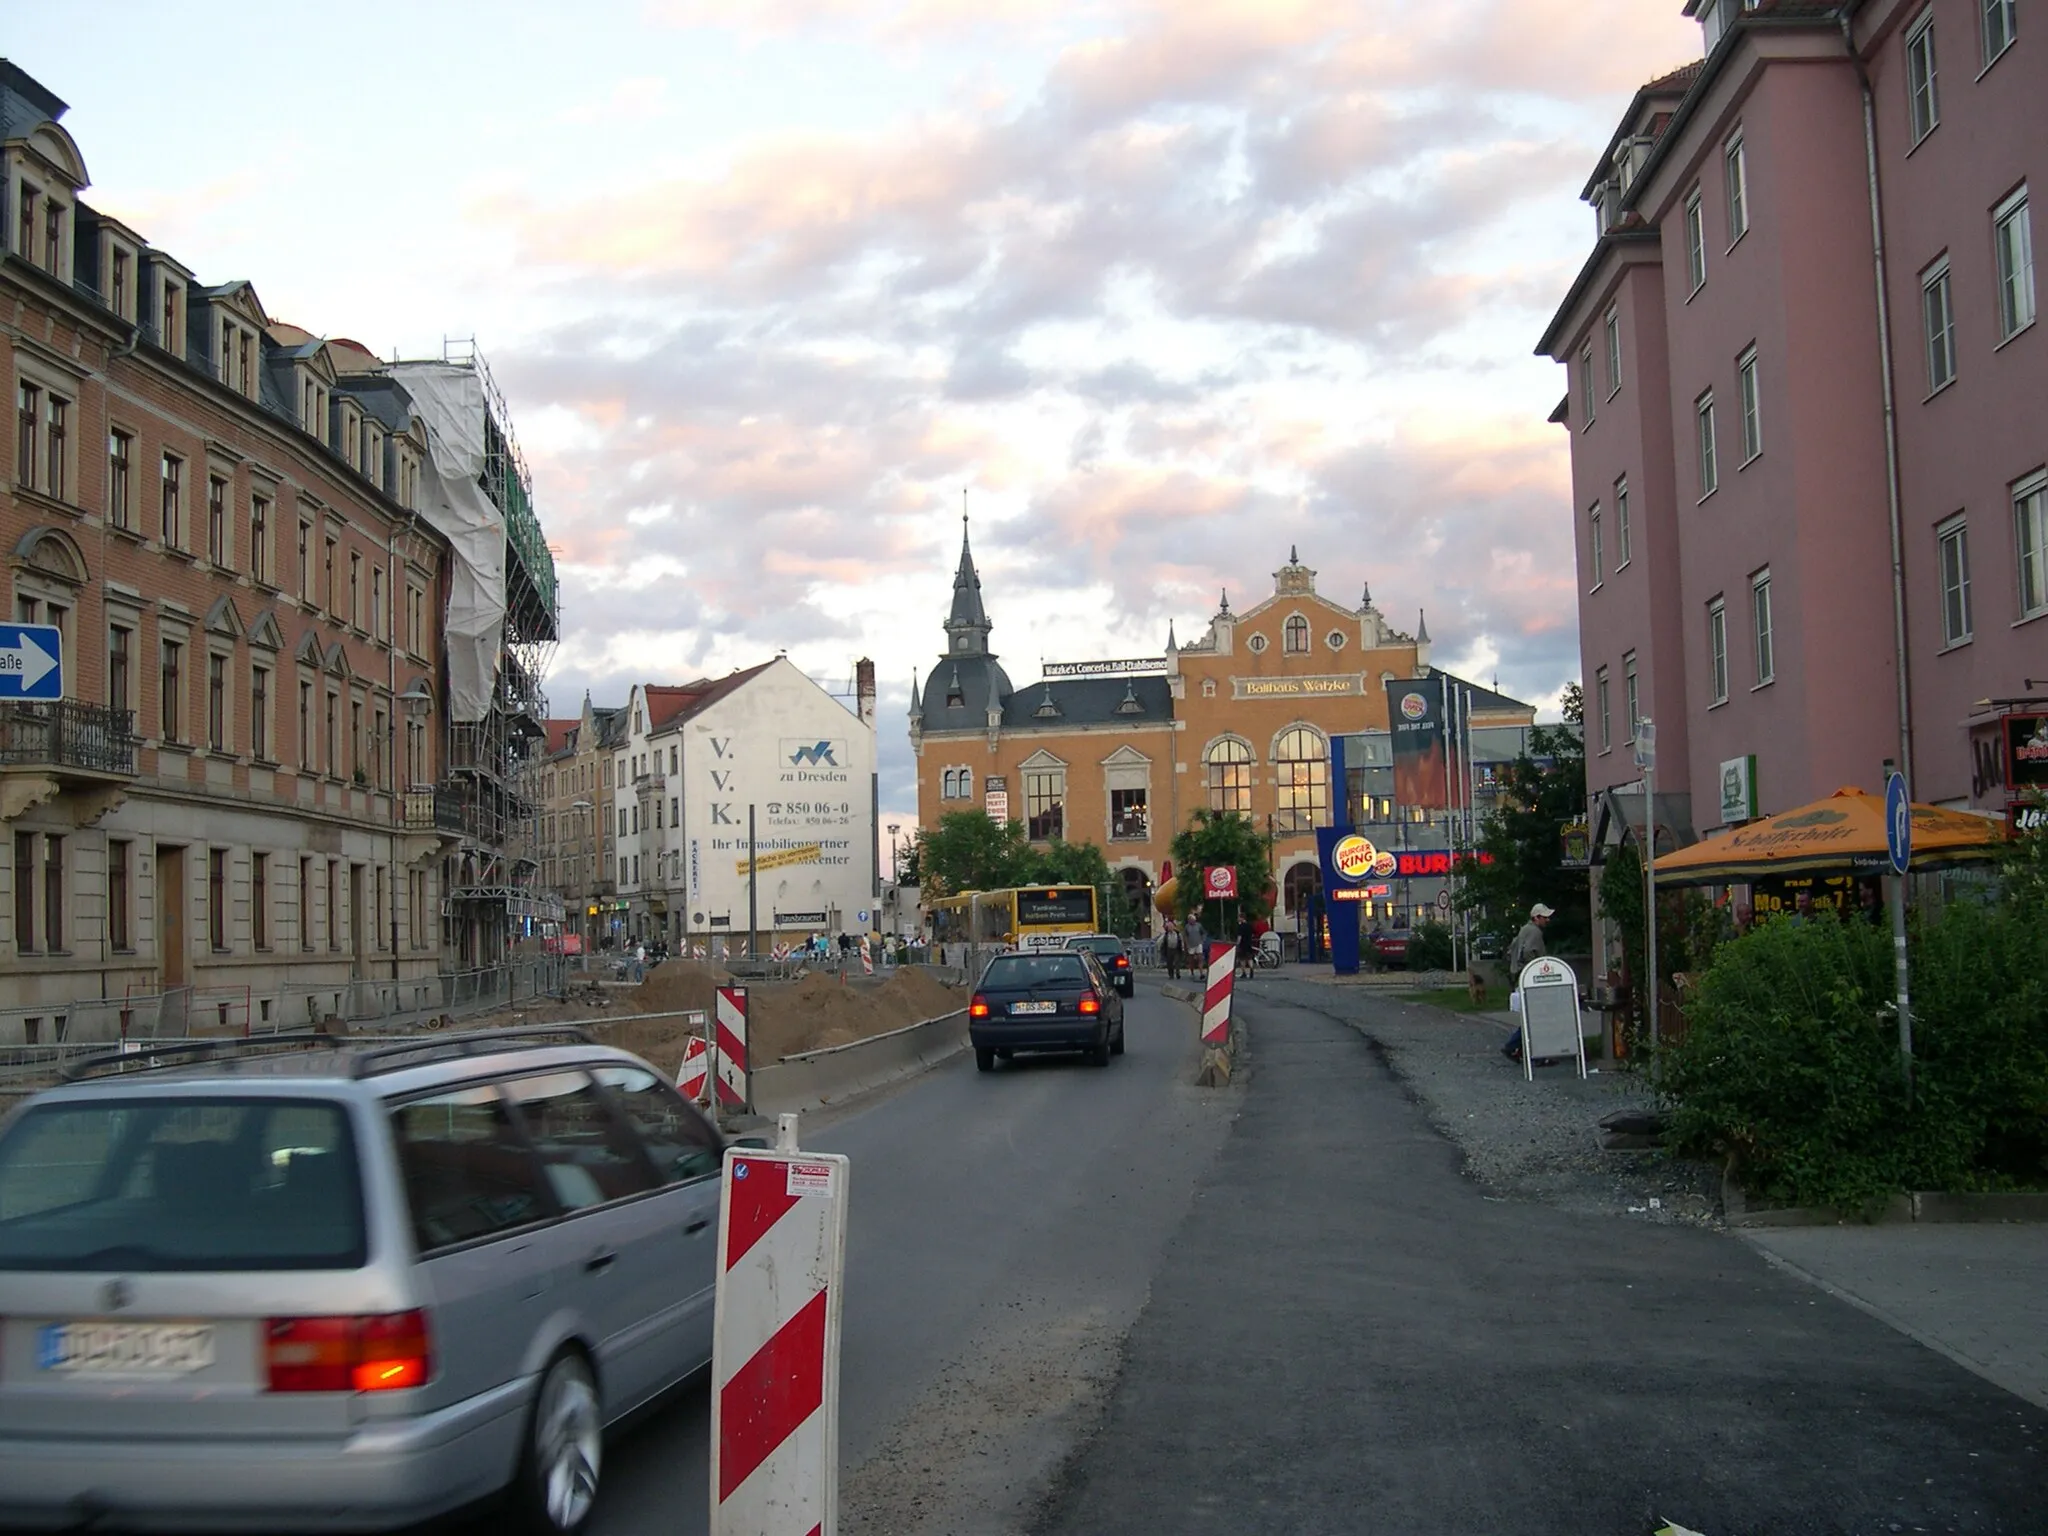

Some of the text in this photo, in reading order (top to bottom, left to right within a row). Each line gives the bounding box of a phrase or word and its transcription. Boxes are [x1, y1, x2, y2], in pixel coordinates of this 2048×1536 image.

[1303, 680, 1351, 693] Watzke
[780, 771, 848, 782] zu Dresden
[787, 802, 810, 814] 850
[712, 839, 732, 850] Ihr
[1340, 843, 1371, 860] BURGER
[1341, 851, 1373, 870] KING
[1754, 893, 1781, 911] Mo
